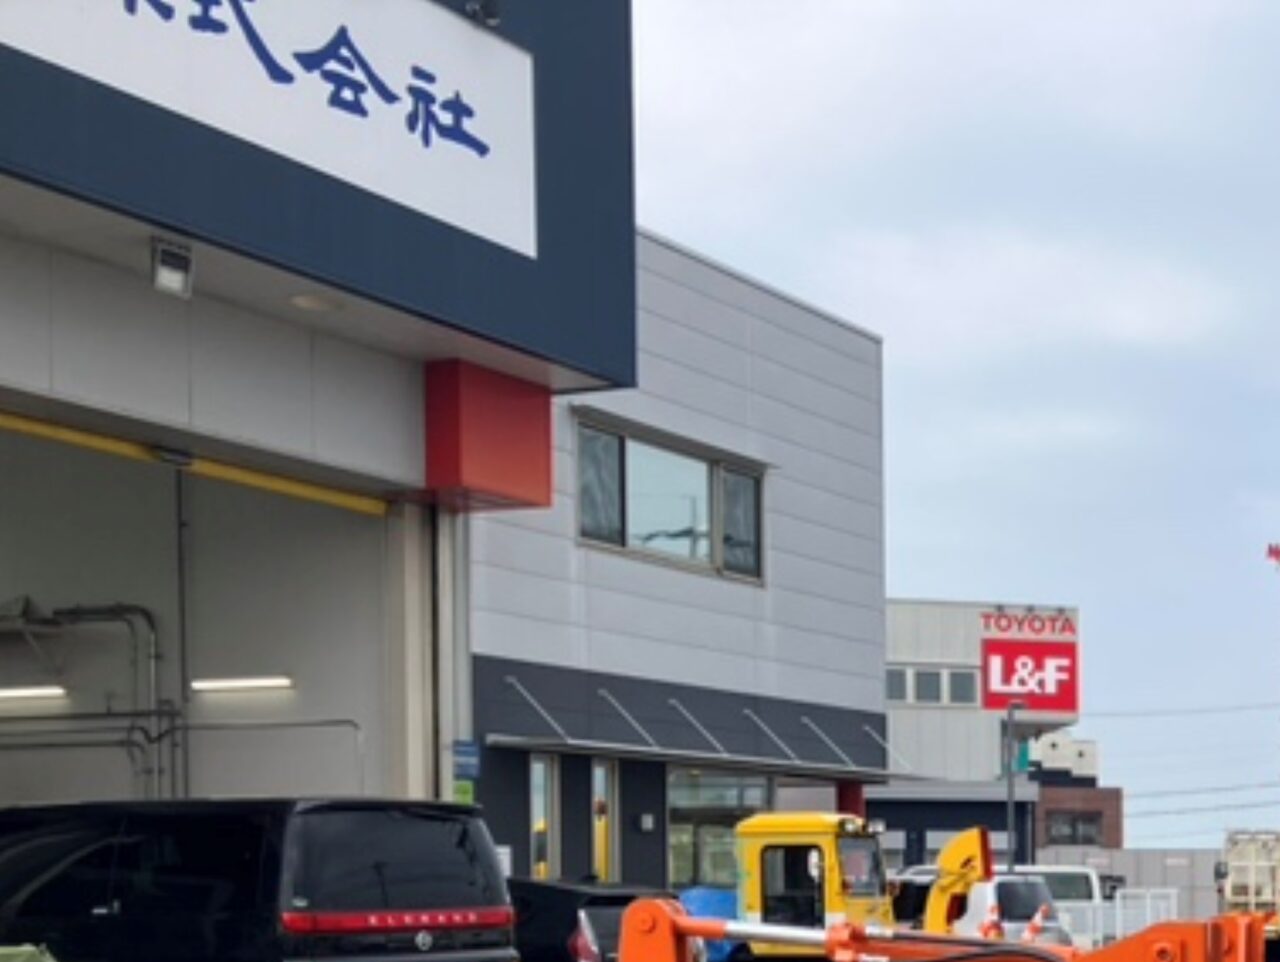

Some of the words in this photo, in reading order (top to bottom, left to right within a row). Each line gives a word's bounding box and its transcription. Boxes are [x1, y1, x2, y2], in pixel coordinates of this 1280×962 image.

[123, 0, 490, 158] 式会社
[980, 612, 1076, 635] TOYOTA
[988, 654, 1071, 695] L&F
